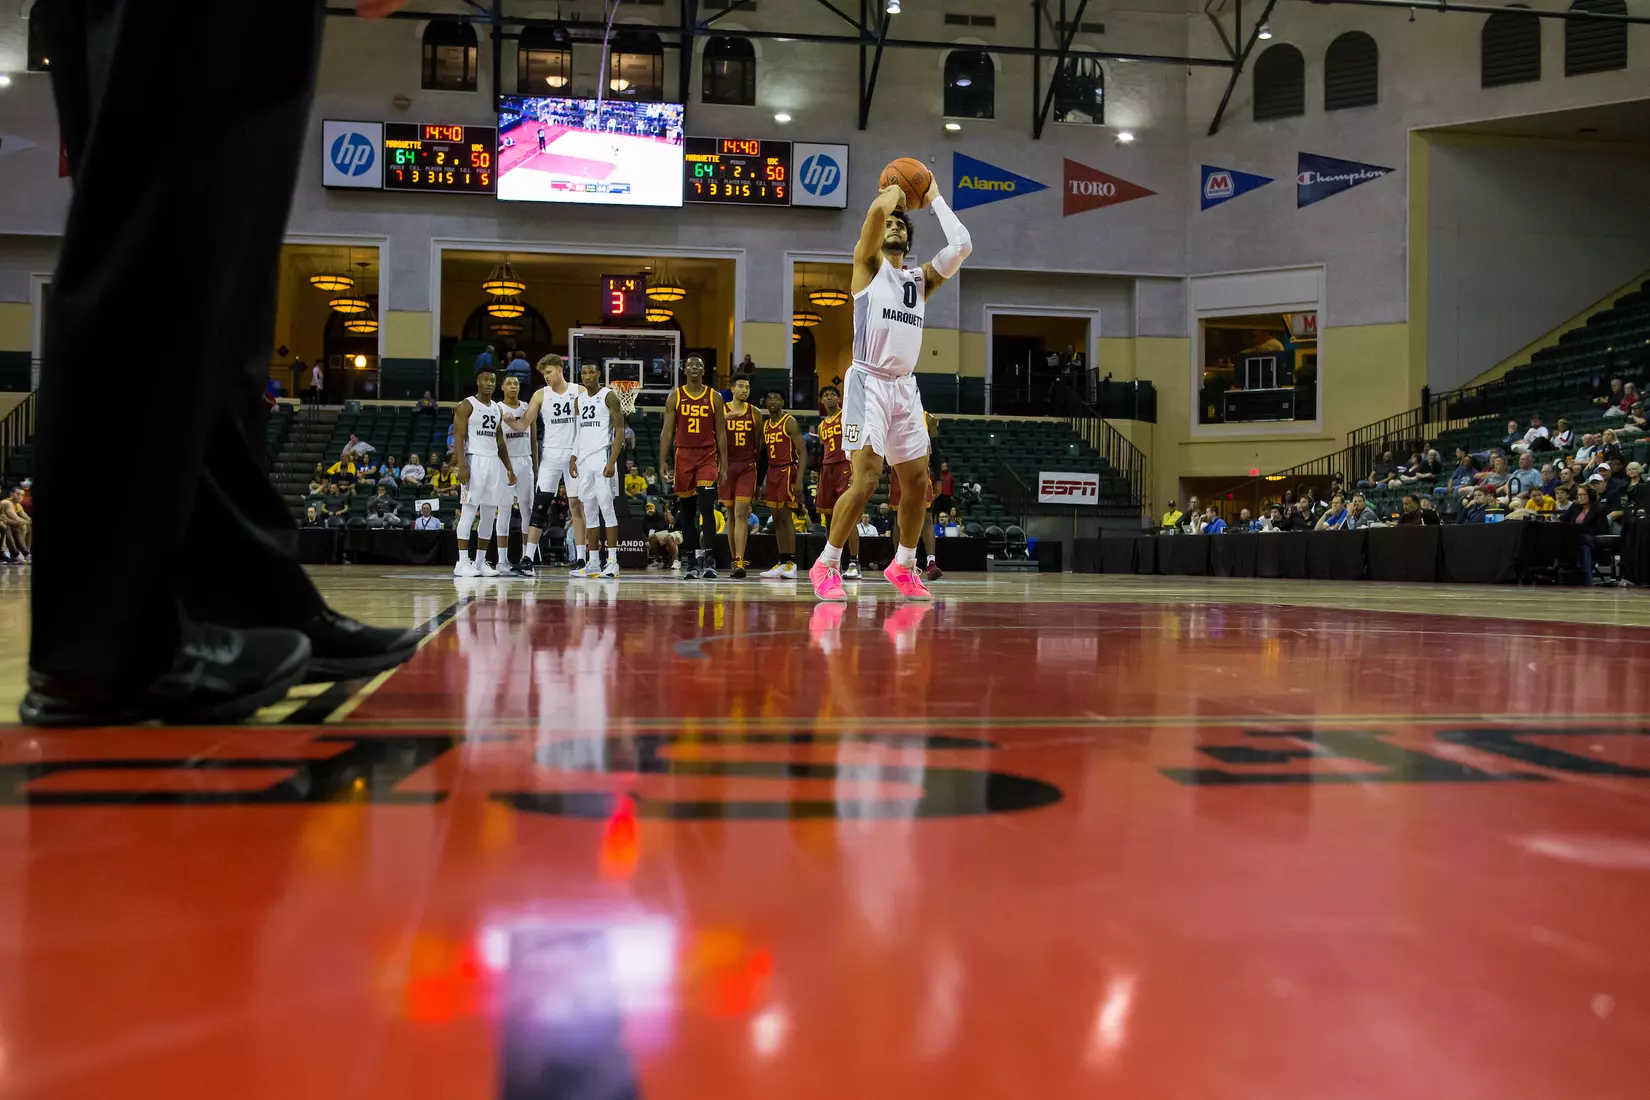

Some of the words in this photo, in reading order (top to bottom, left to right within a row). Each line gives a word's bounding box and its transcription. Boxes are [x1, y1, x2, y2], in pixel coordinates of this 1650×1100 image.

[426, 126, 462, 141] 14:40
[386, 140, 421, 149] MARQUETTE
[471, 144, 484, 152] USC
[724, 140, 758, 155] 14:40
[335, 132, 371, 177] hp
[395, 149, 415, 164] 64
[436, 152, 445, 164] 2
[471, 152, 490, 167] 50
[685, 154, 720, 163] MARQUETTE
[412, 170, 419, 183] 3
[481, 173, 489, 185] 5
[694, 163, 713, 177] 64
[733, 166, 742, 177] 2
[766, 166, 785, 180] 50
[803, 154, 838, 196] hp
[1297, 168, 1387, 187] Champion
[958, 175, 1015, 192] Alamo
[1069, 180, 1116, 197] TORO
[1209, 175, 1229, 190] M
[710, 183, 717, 195] 3
[776, 186, 784, 198] 5
[612, 291, 624, 313] 3
[903, 281, 917, 308] 0
[553, 402, 571, 416] 34
[582, 405, 596, 420] 23
[681, 404, 709, 417] USC
[482, 414, 496, 429] 25
[688, 418, 700, 433] 21
[727, 420, 752, 431] USC
[735, 433, 746, 446] 15
[764, 432, 783, 444] USC
[820, 424, 842, 440] USC
[769, 445, 776, 459] 2
[829, 438, 836, 451] 3
[1041, 480, 1097, 496] ESPN
